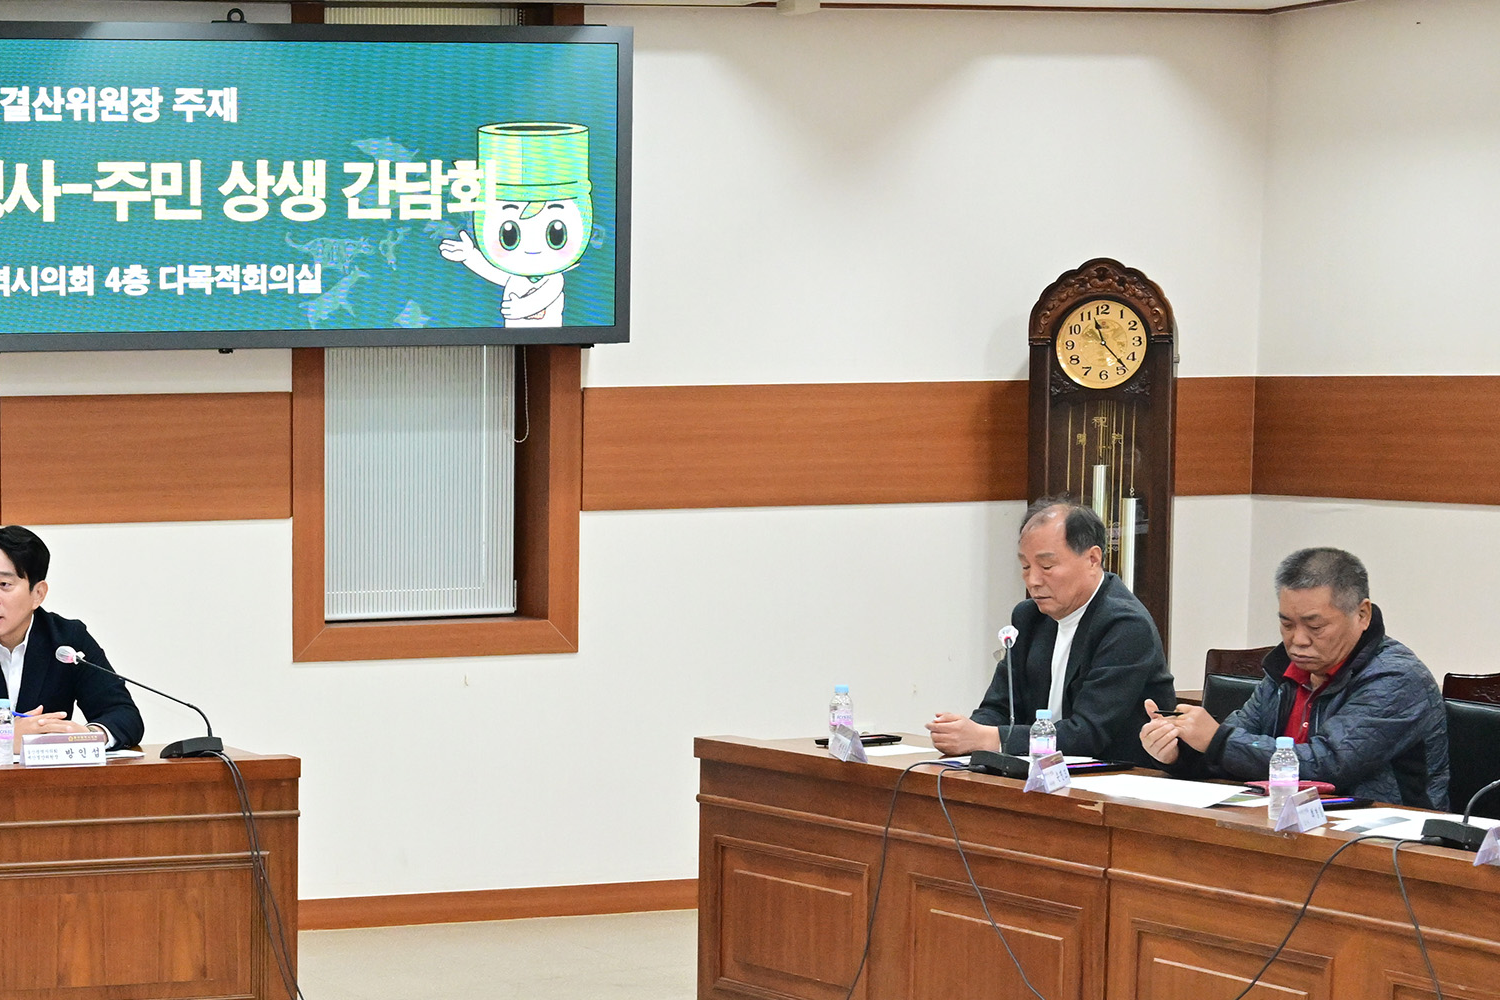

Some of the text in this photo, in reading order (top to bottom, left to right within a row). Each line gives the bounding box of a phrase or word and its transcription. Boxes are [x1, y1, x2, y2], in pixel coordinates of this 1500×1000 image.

[172, 86, 238, 123] 주재
[217, 159, 327, 222] 상생
[341, 159, 497, 221] 간담회
[104, 264, 151, 296] 4층
[159, 263, 322, 296] 다목적회의실
[1095, 304, 1110, 315] 12
[1119, 309, 1124, 319] 1
[1080, 311, 1091, 322] 11
[1069, 324, 1081, 335] 10
[1128, 320, 1138, 331] 2
[1065, 340, 1075, 350] 9
[1132, 336, 1142, 347] 3
[1069, 355, 1080, 365] 8
[1126, 352, 1136, 361] 4
[1082, 366, 1092, 376] 7
[1099, 370, 1108, 380] 6
[1116, 366, 1127, 375] 5
[65, 747, 100, 759] 방인섭
